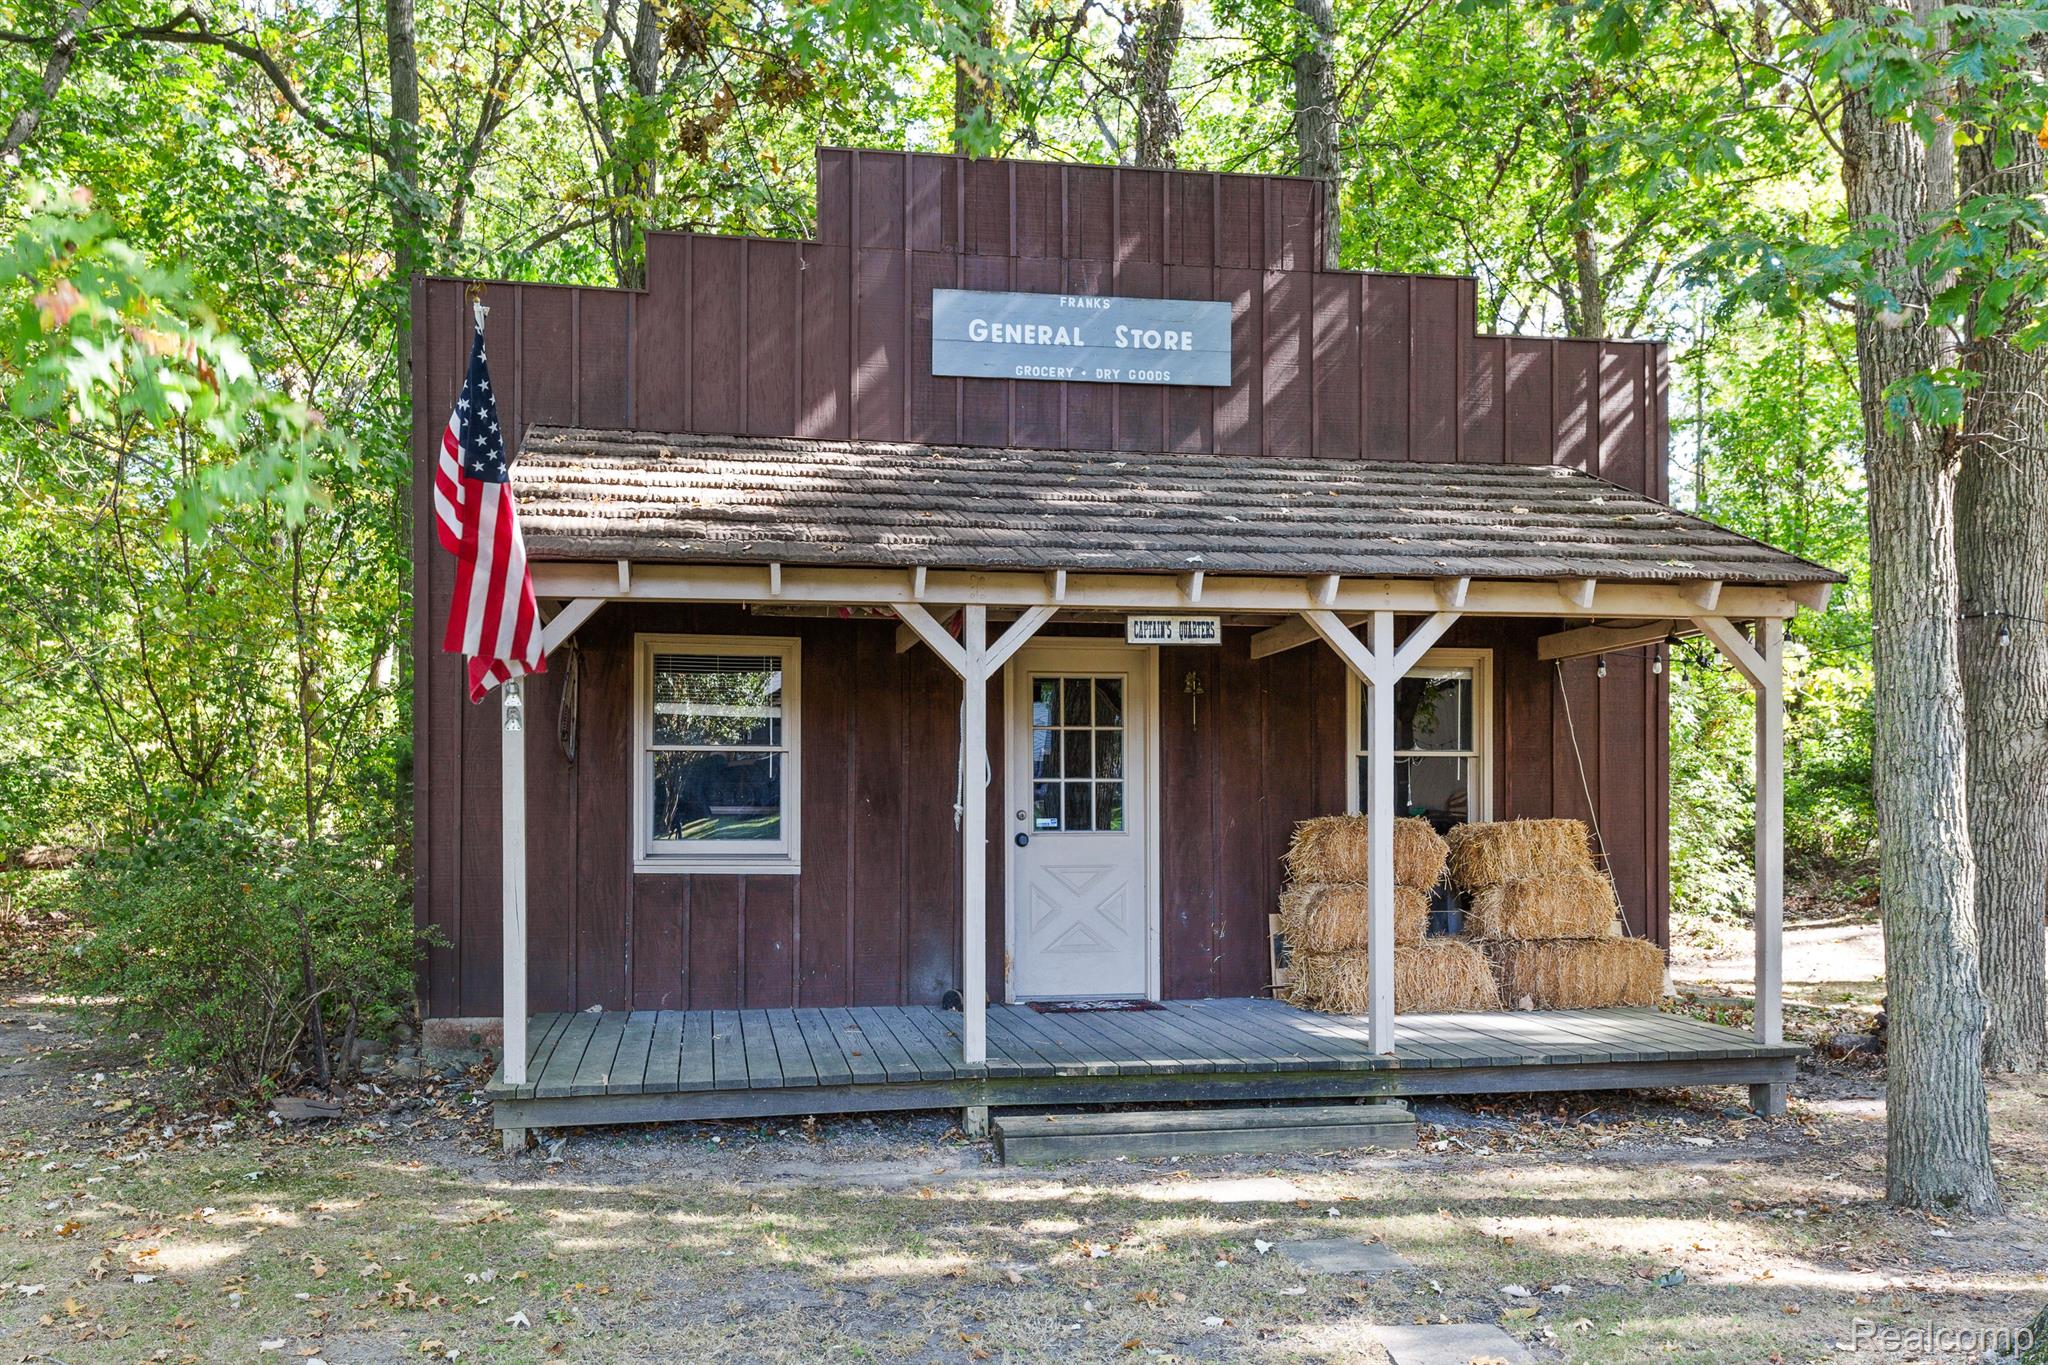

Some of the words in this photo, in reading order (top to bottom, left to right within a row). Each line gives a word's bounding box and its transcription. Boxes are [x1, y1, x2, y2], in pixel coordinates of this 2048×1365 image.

[968, 318, 1085, 347] GENERAL
[1115, 324, 1193, 351] STORE
[1015, 365, 1074, 378] GROCERY
[1096, 368, 1120, 380] DRY
[1128, 369, 1171, 382] GOODS
[1133, 620, 1172, 639] CAPTAIN'S
[1179, 621, 1215, 640] QUARTERS
